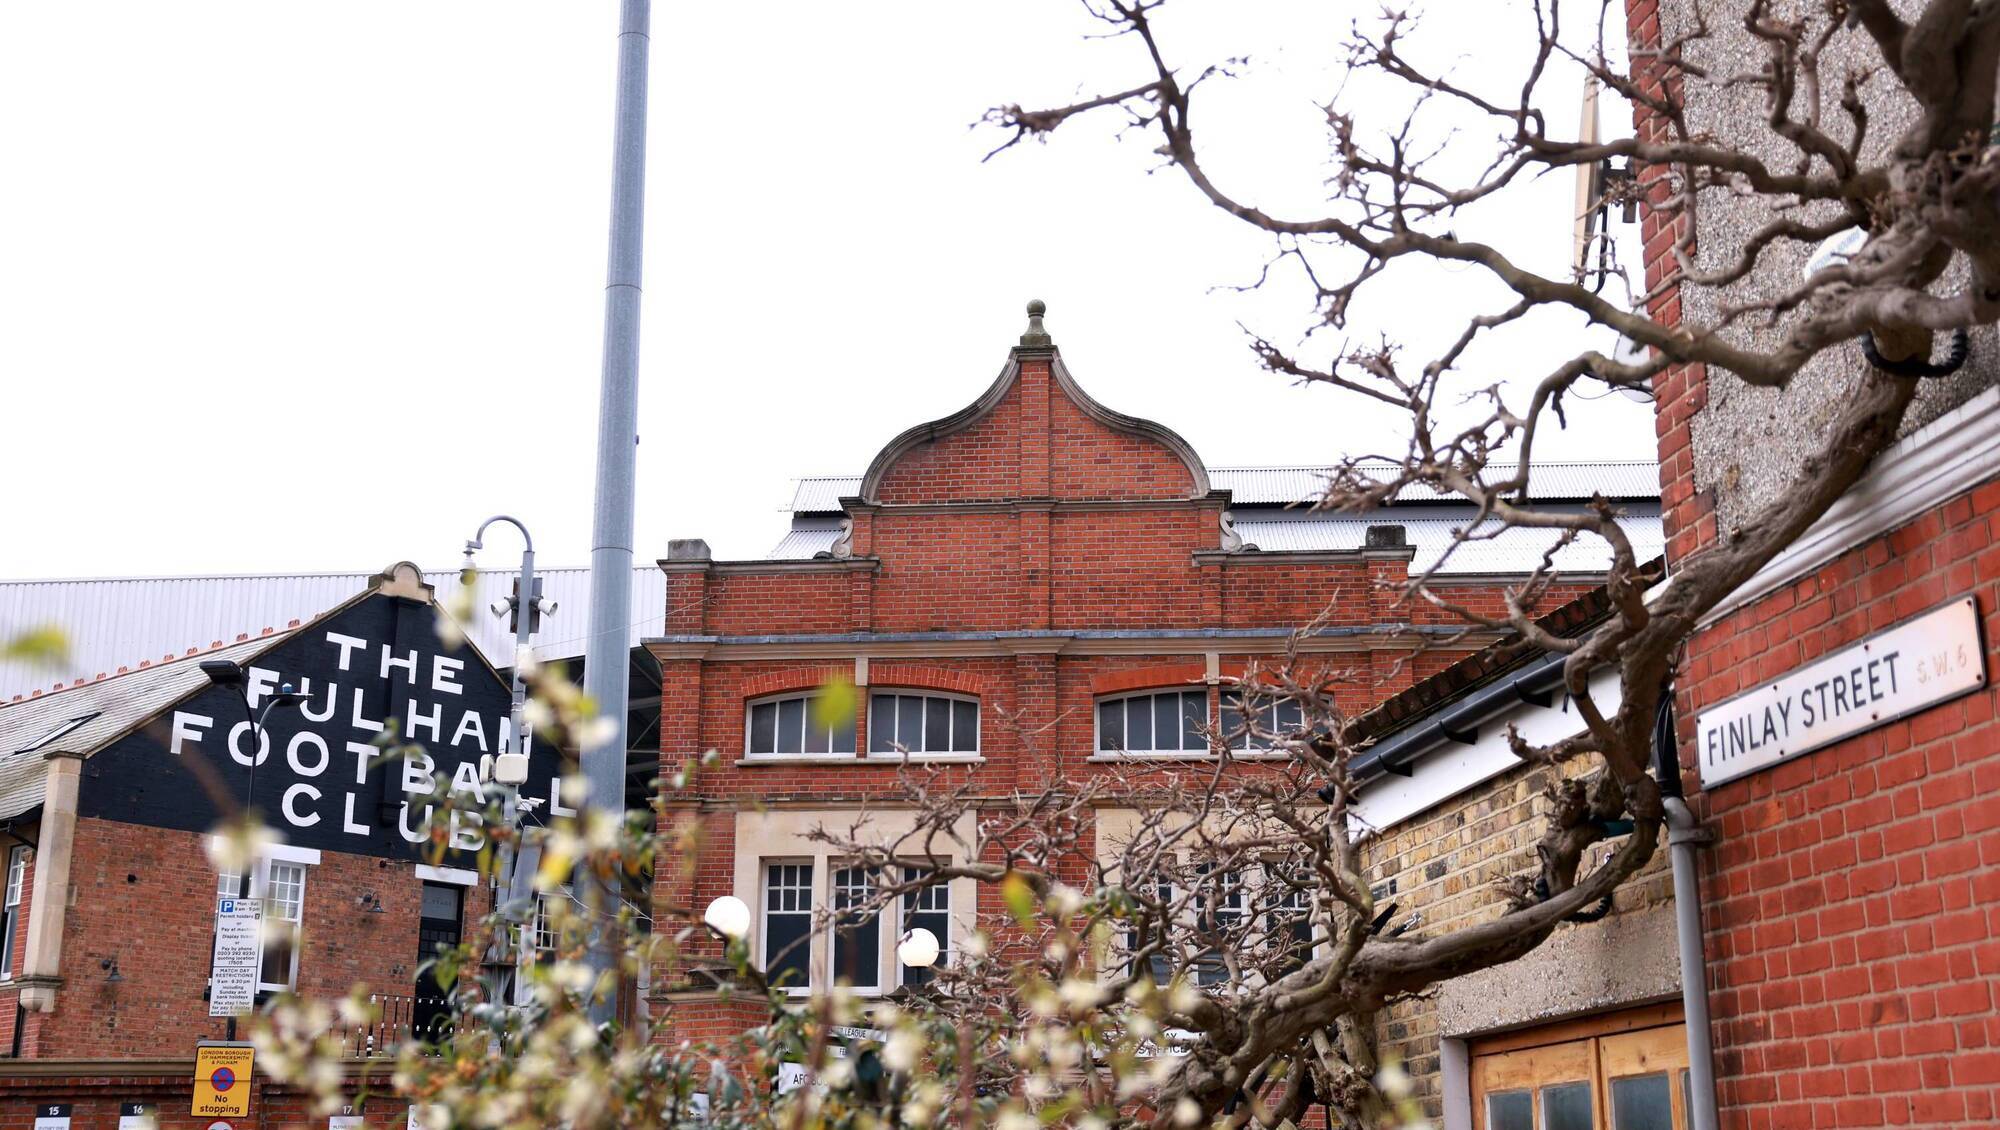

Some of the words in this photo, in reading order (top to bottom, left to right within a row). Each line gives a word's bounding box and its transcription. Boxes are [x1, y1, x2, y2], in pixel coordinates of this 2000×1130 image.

[326, 631, 463, 696] THE
[1707, 696, 1792, 767] FINLAY
[1801, 651, 1900, 728] STREET
[170, 710, 577, 819] FOOTBAL
[282, 782, 486, 852] CLUB
[223, 901, 232, 912] P
[844, 1028, 867, 1039] LEAGUE
[214, 1095, 228, 1103] No
[48, 1105, 60, 1116] 15
[132, 1105, 144, 1115] 16
[199, 1104, 240, 1115] stopping
[342, 1105, 353, 1115] 17
